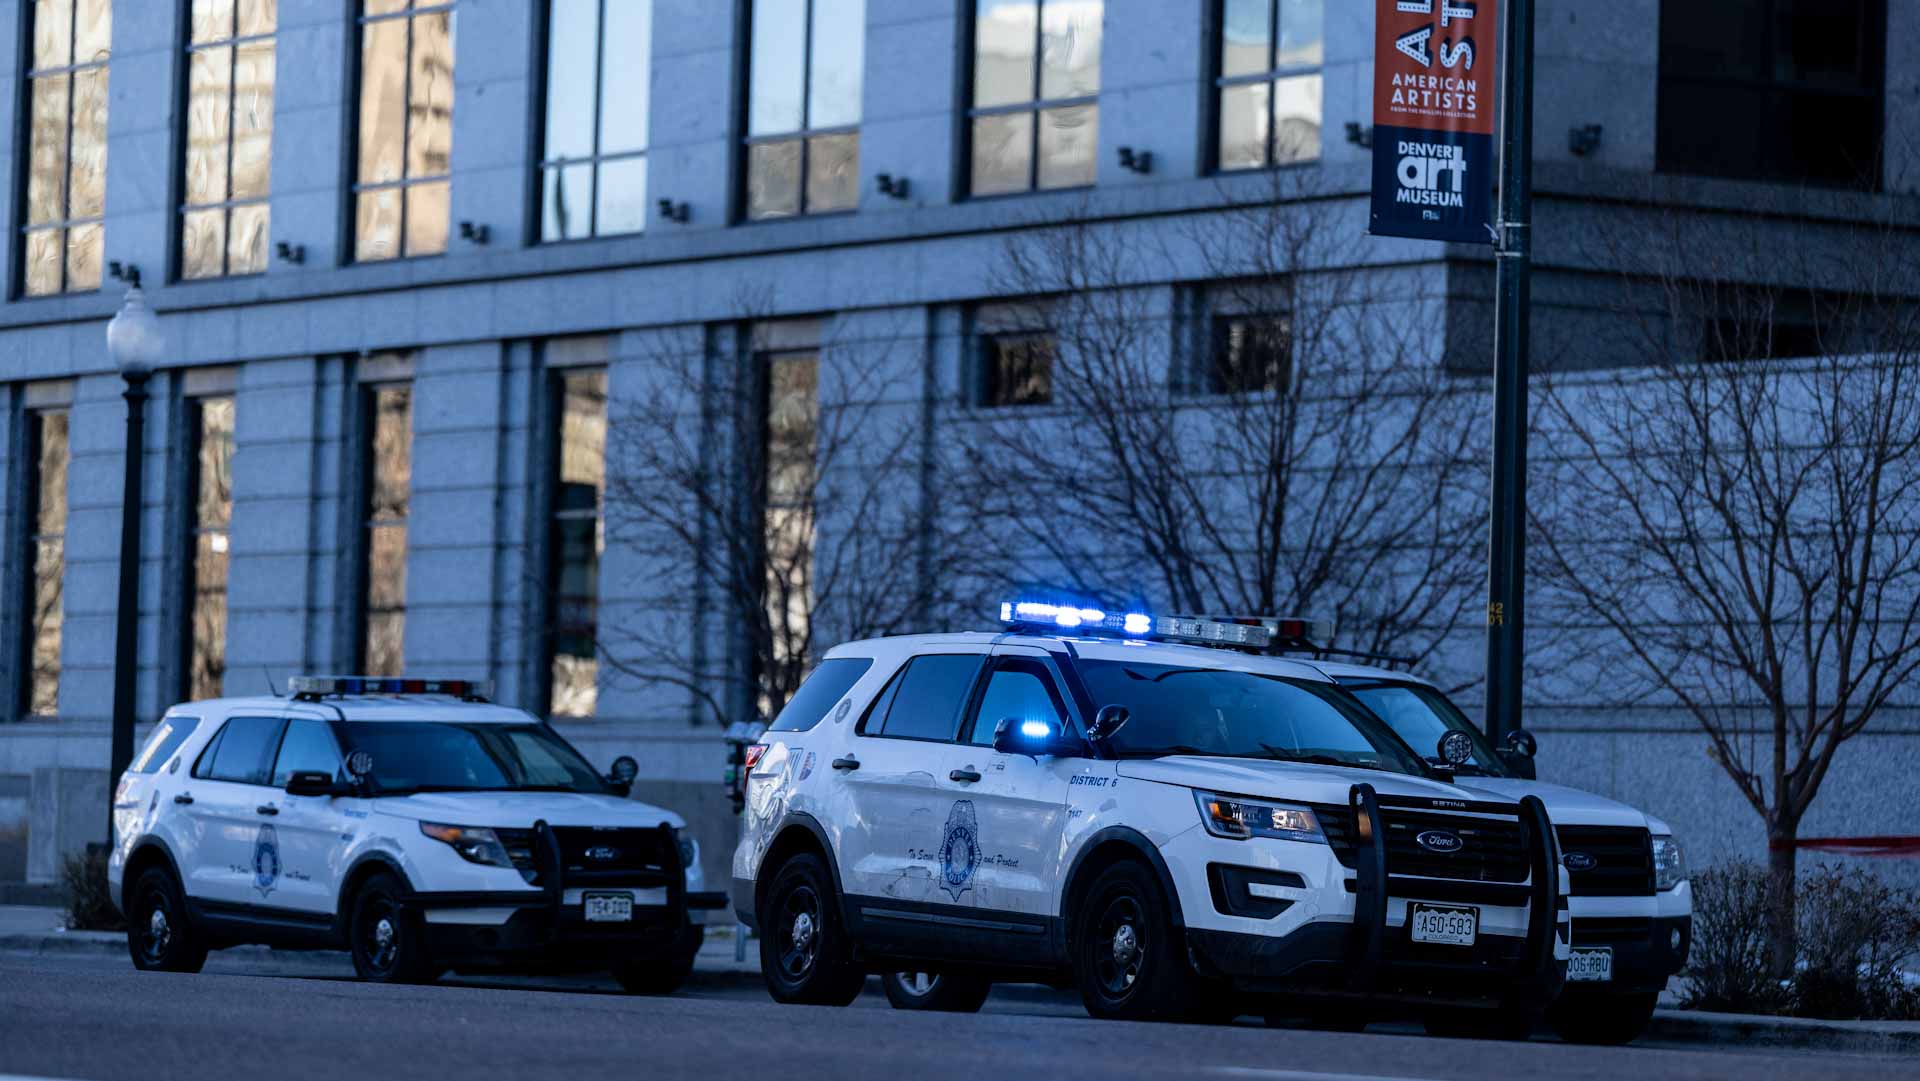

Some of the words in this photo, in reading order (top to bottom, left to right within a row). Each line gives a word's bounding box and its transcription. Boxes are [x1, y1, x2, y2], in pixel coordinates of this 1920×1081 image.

[1392, 72, 1476, 93] AMERICAN
[1391, 87, 1477, 111] ARTISTS
[1398, 140, 1453, 159] DENVER
[1397, 145, 1467, 192] art
[1397, 188, 1464, 208] MUSEUM
[1070, 775, 1109, 787] DISTRICT
[1112, 778, 1118, 787] 6
[1428, 835, 1455, 847] Ford
